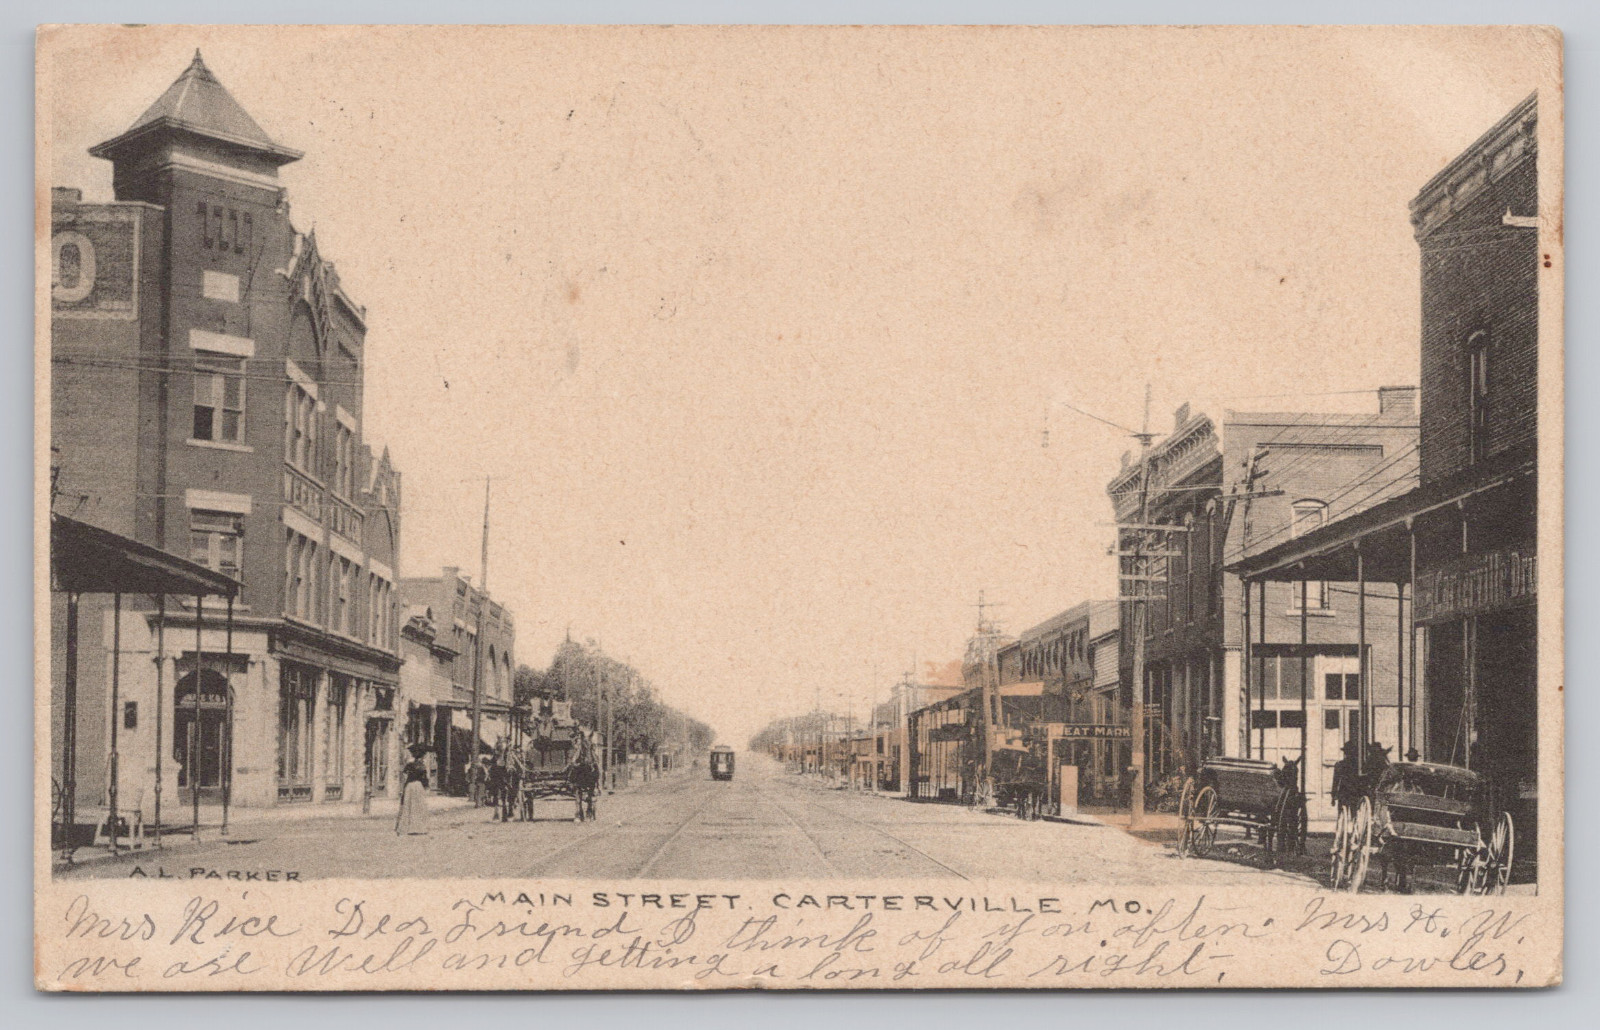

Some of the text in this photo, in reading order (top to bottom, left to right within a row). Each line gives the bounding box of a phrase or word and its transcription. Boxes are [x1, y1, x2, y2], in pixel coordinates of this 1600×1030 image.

[65, 894, 156, 941] Mrs
[169, 891, 299, 945] Rice
[328, 897, 433, 940] Dear
[444, 898, 642, 944] Friend
[722, 912, 877, 951] think
[898, 910, 962, 961] of
[981, 913, 1093, 954] you
[1295, 896, 1389, 933] Mrs
[162, 951, 262, 978] are
[442, 930, 556, 970] and
[562, 935, 738, 980] getting
[937, 941, 1014, 978] all
